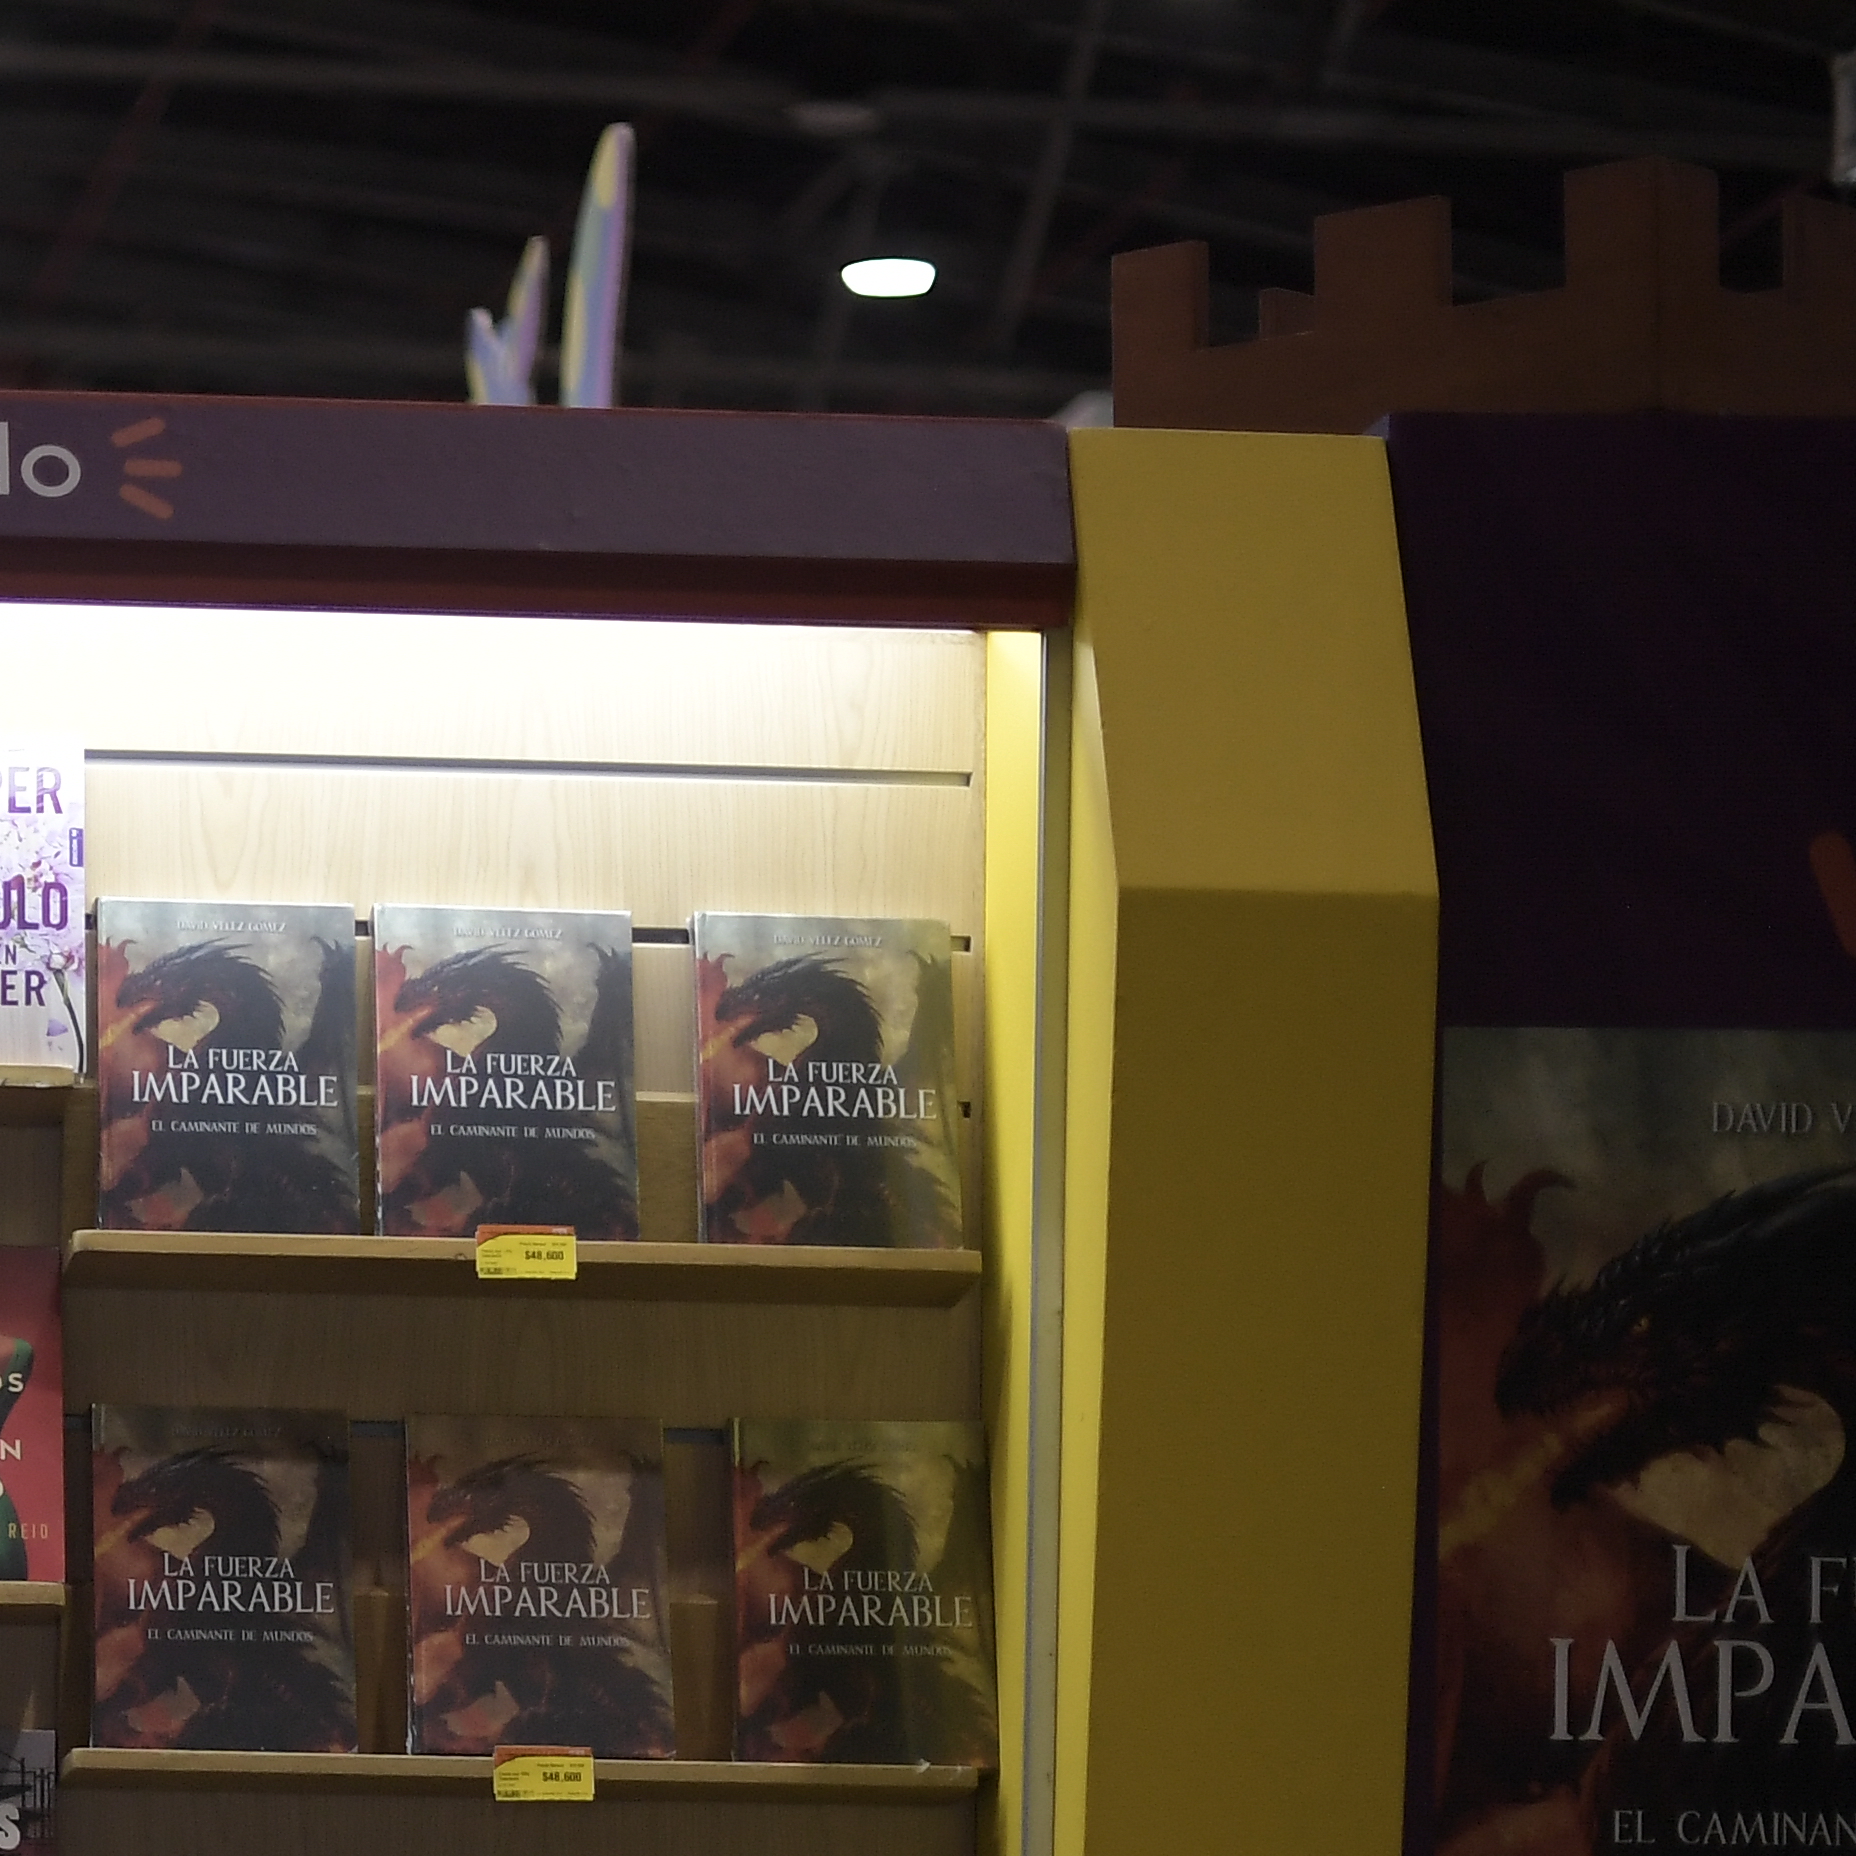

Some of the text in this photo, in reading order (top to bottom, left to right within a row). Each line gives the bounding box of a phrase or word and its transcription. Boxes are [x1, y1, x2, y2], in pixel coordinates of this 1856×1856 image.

[167, 1045, 299, 1072] LA FUERZA
[446, 1051, 577, 1079] LA FUERZA
[132, 1071, 338, 1107] IMPARABLE
[410, 1076, 616, 1113] IMPARABLE
[152, 1120, 317, 1135] EL CAMINANTE DE MUNDOS
[1713, 1103, 1812, 1133] DAVID
[203, 1555, 295, 1581] FUERZA
[1672, 1544, 1774, 1623] LA
[127, 1579, 334, 1614] IMPARABLE
[1549, 1638, 1856, 1744] IMPA
[1614, 1810, 1655, 1843] EL
